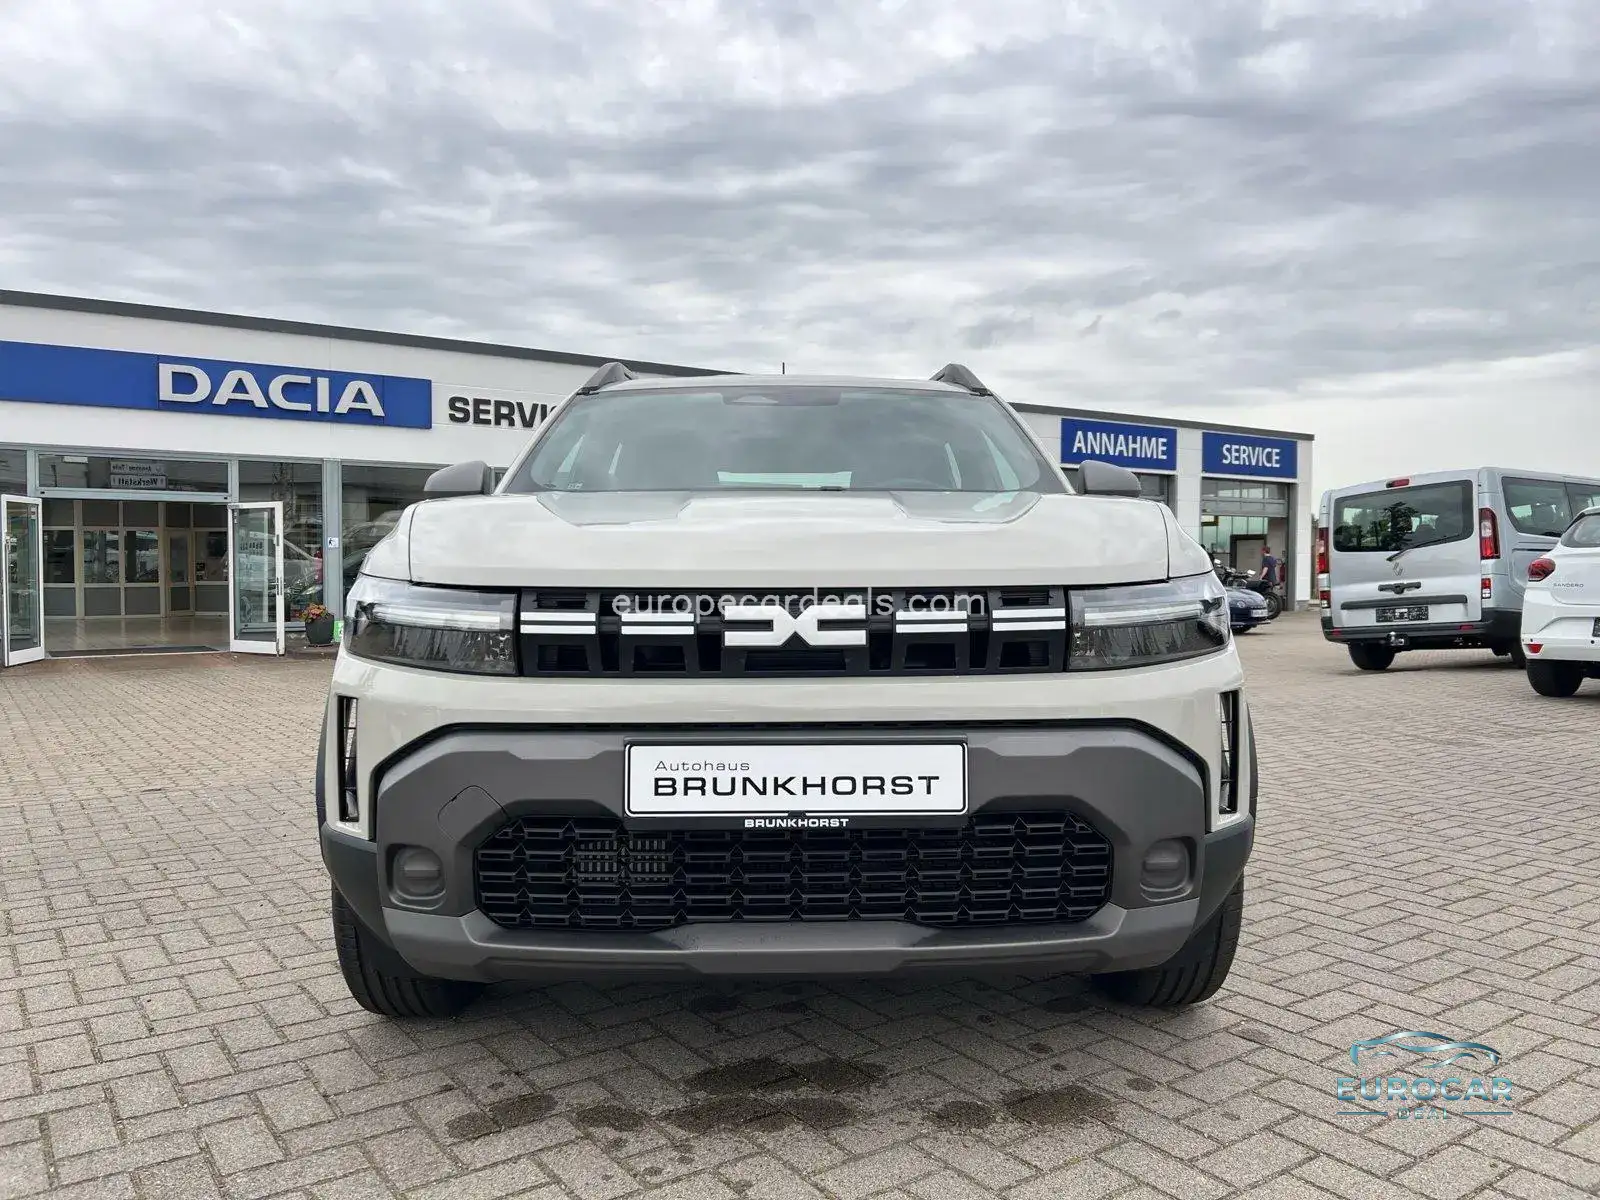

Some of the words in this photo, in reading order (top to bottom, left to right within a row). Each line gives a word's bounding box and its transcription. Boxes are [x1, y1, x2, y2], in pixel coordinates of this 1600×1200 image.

[158, 363, 385, 417] DACIA
[448, 396, 557, 428] SERVI
[1072, 430, 1168, 460] ANNAHME
[1222, 443, 1281, 468] SERVICE
[654, 760, 750, 772] Autohaus
[653, 776, 940, 797] BRUNKHORST
[744, 817, 849, 828] BRUNKHORST
